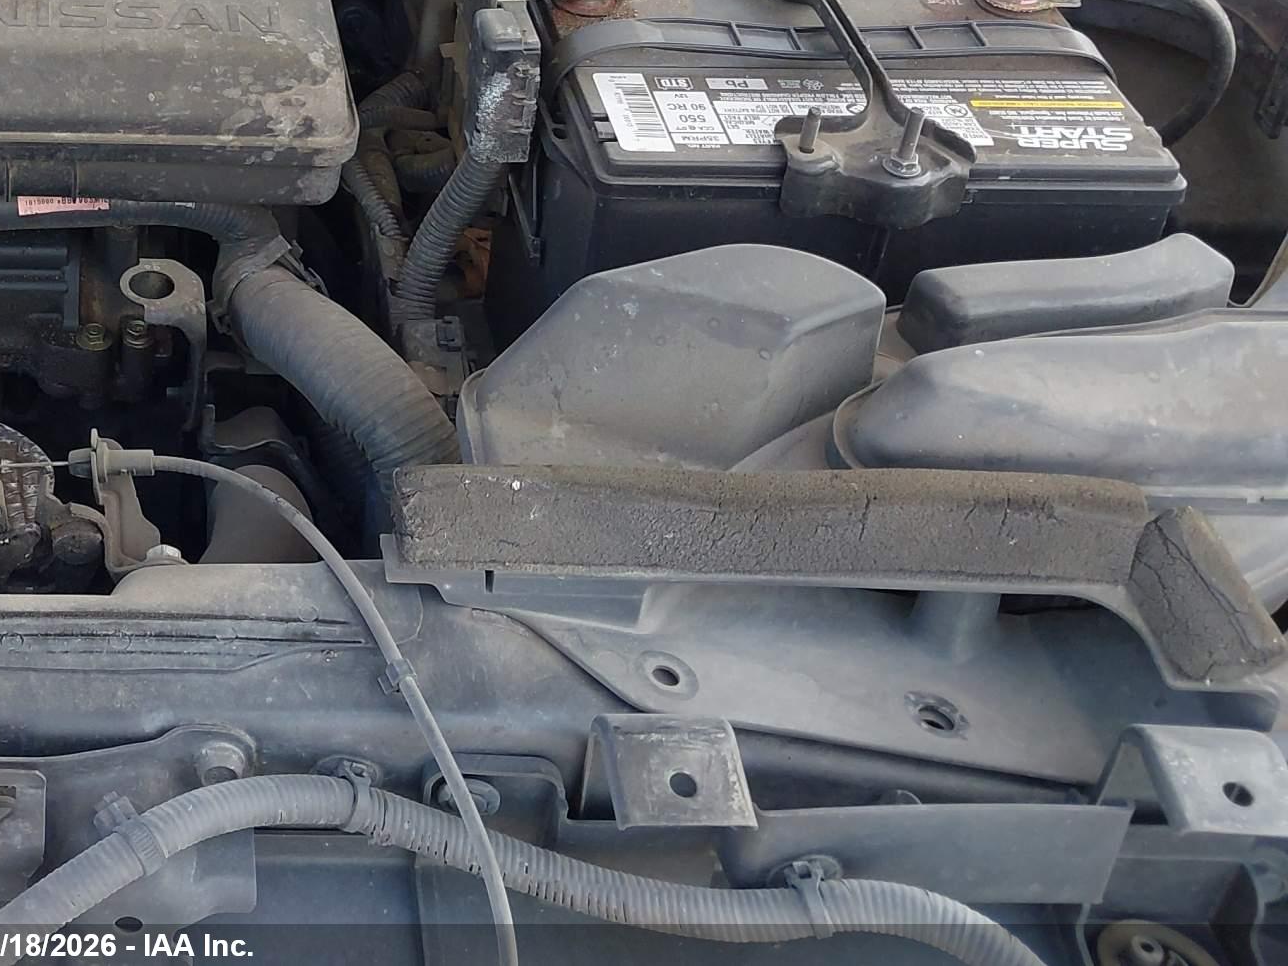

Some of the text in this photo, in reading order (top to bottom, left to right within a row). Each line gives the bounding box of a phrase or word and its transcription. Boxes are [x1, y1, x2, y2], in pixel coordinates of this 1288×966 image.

[725, 79, 749, 88] Pb
[666, 102, 707, 111] 90 RC
[679, 114, 706, 123] 550
[1019, 127, 1134, 141] START
[1017, 138, 1129, 151] SUPER
